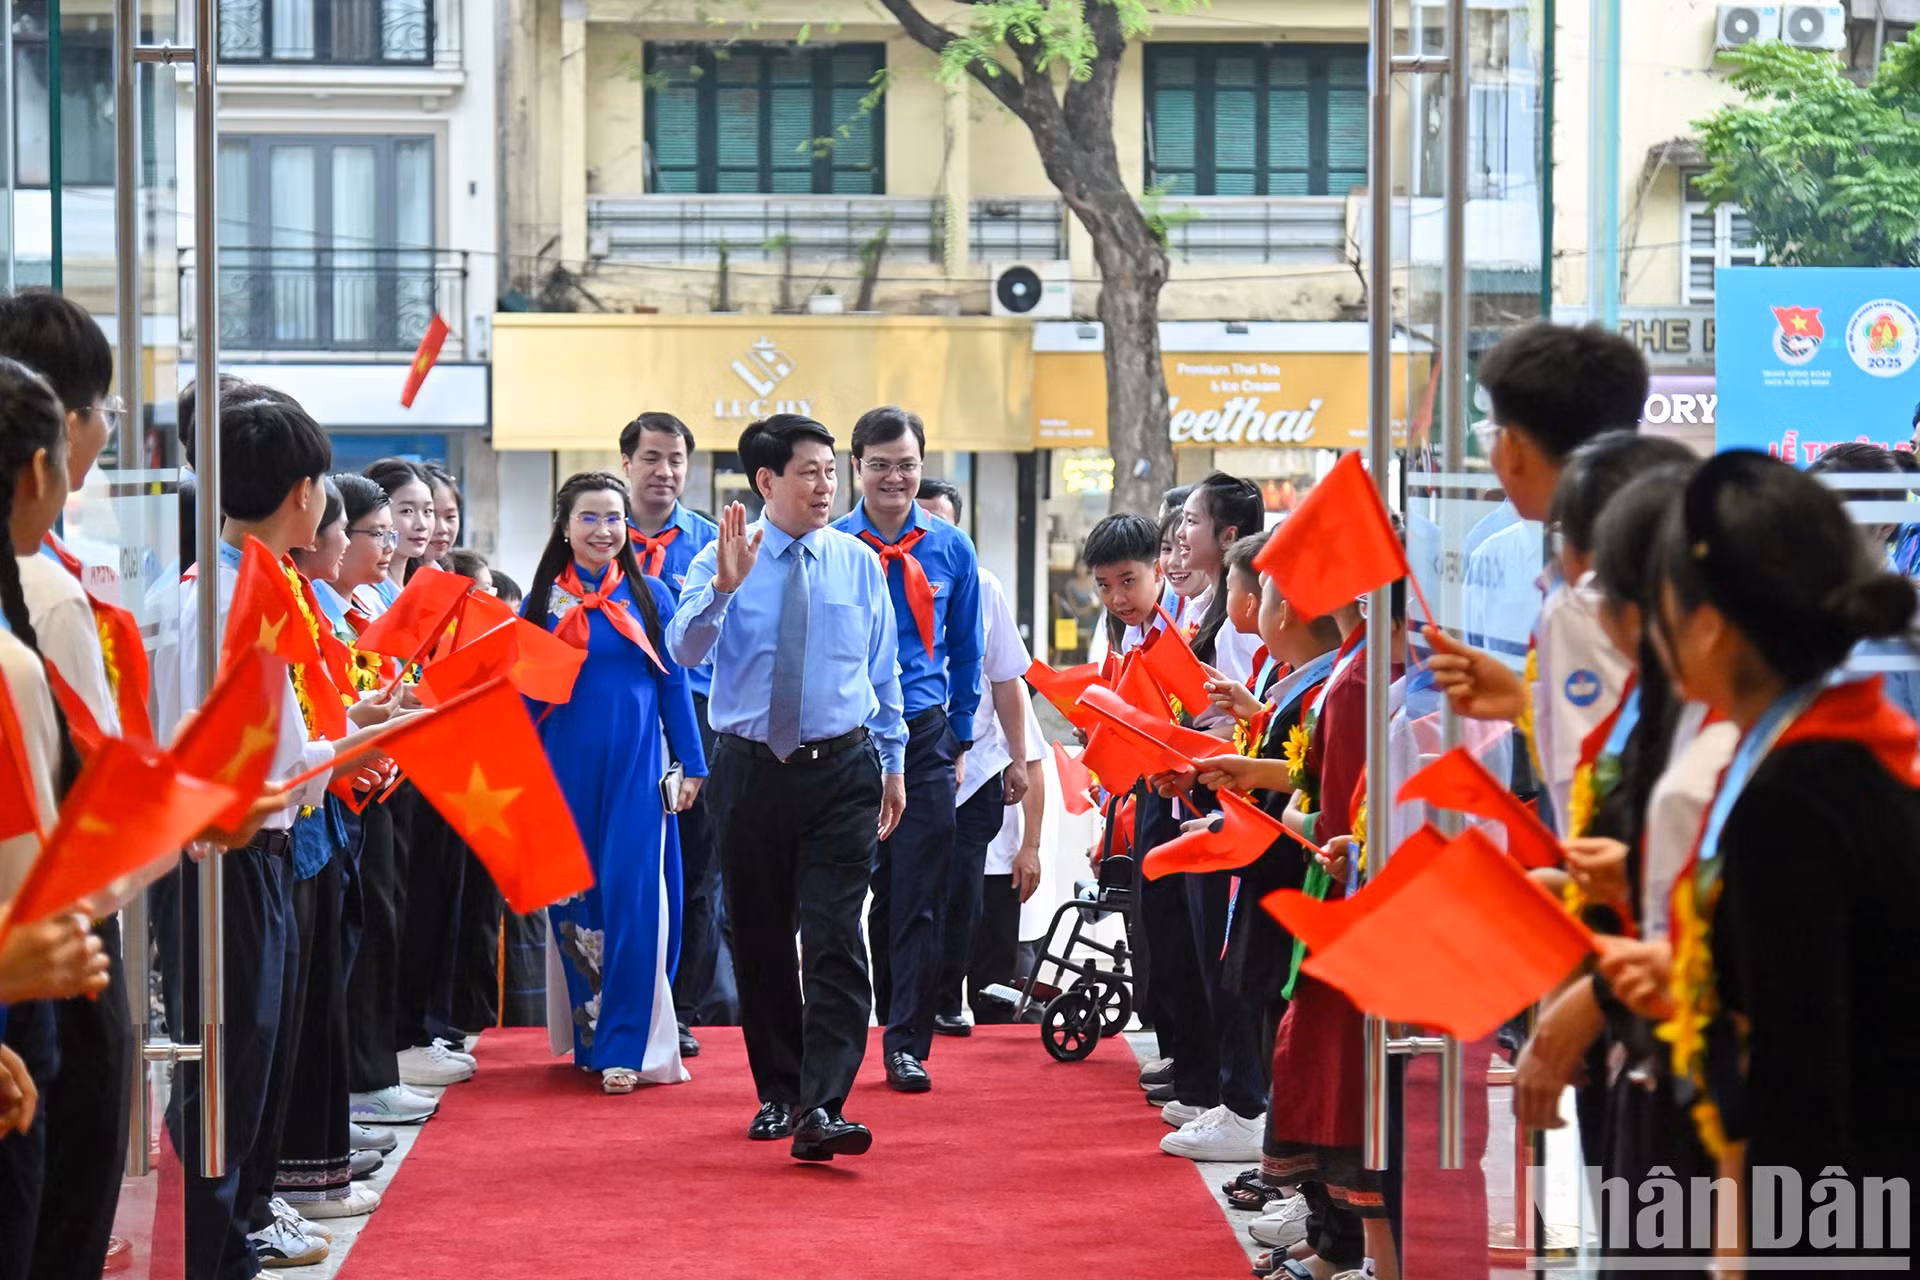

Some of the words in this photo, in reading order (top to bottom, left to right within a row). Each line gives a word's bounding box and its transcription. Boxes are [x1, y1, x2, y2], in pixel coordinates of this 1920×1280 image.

[1867, 357, 1901, 368] 2025
[1177, 363, 1230, 375] Premium
[1242, 380, 1281, 392] Cream
